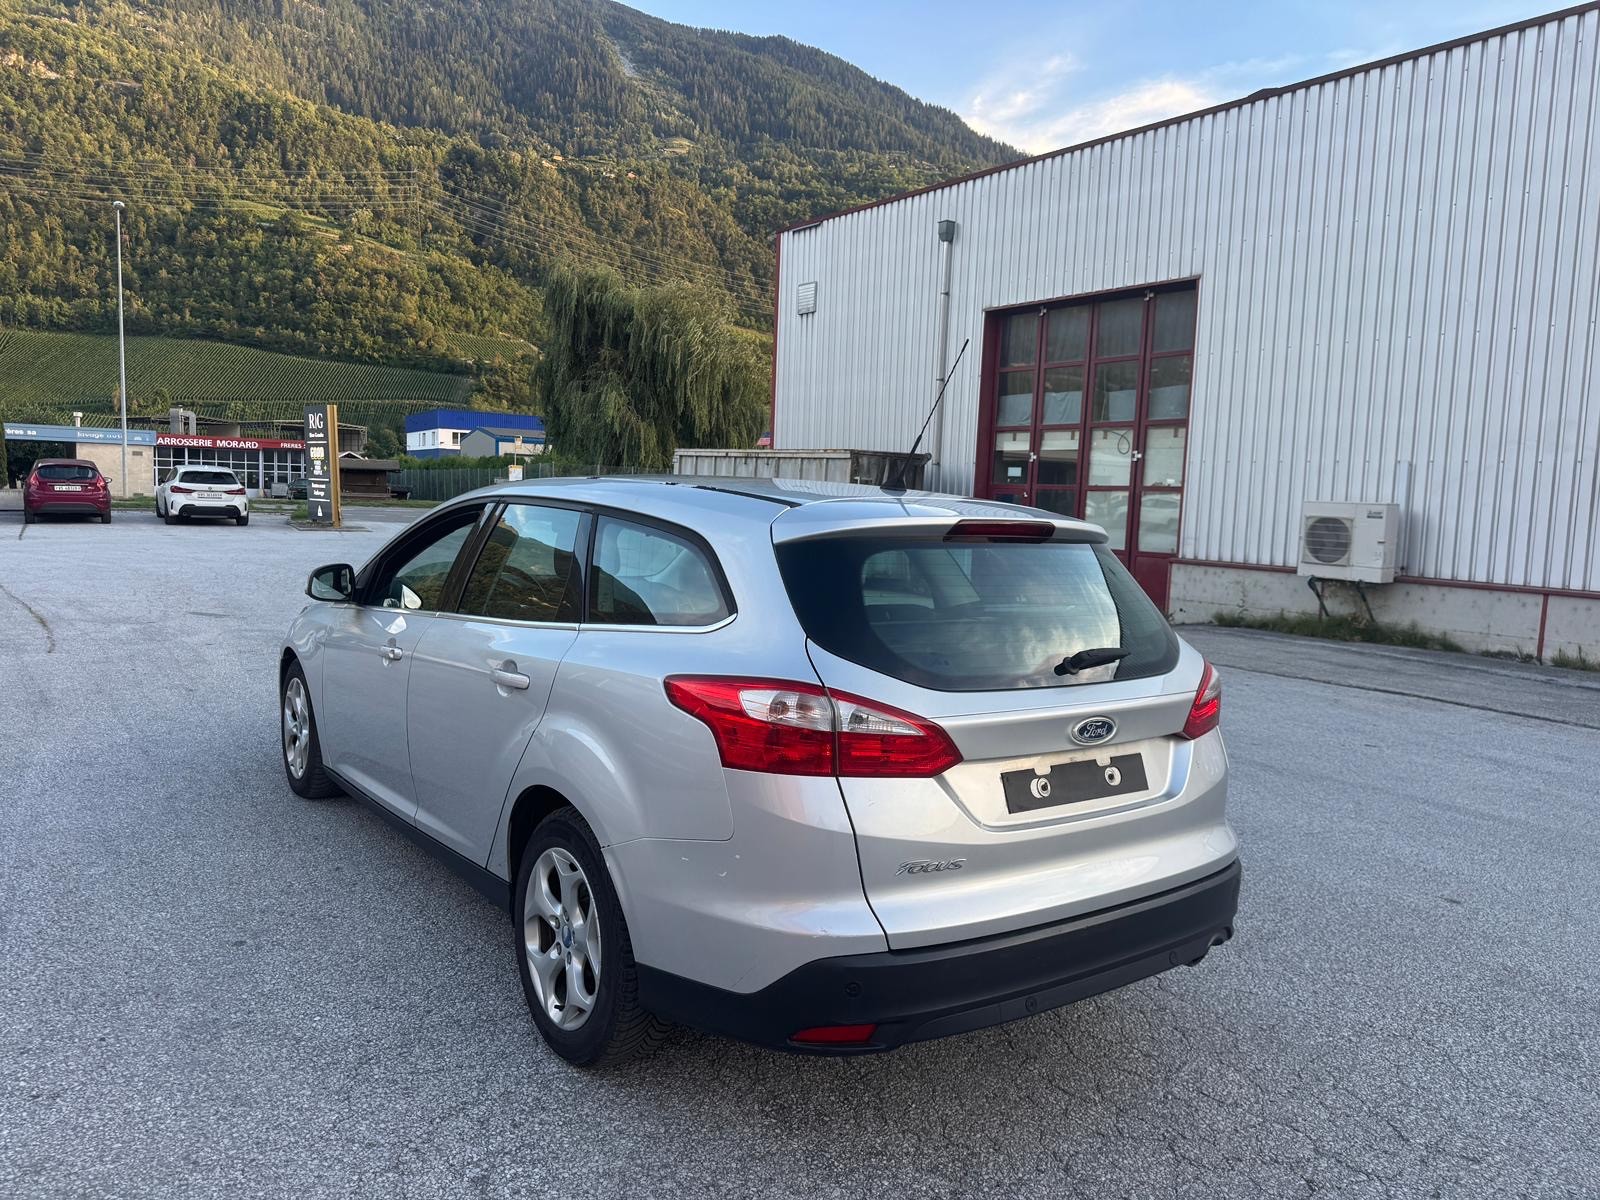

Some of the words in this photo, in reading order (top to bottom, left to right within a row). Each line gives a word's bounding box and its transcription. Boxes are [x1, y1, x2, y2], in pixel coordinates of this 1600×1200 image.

[5, 428, 24, 436] ères
[77, 431, 105, 440] lavage
[156, 437, 213, 447] ARROSSERIE
[216, 439, 259, 449] MORARD
[1083, 721, 1109, 738] Ford
